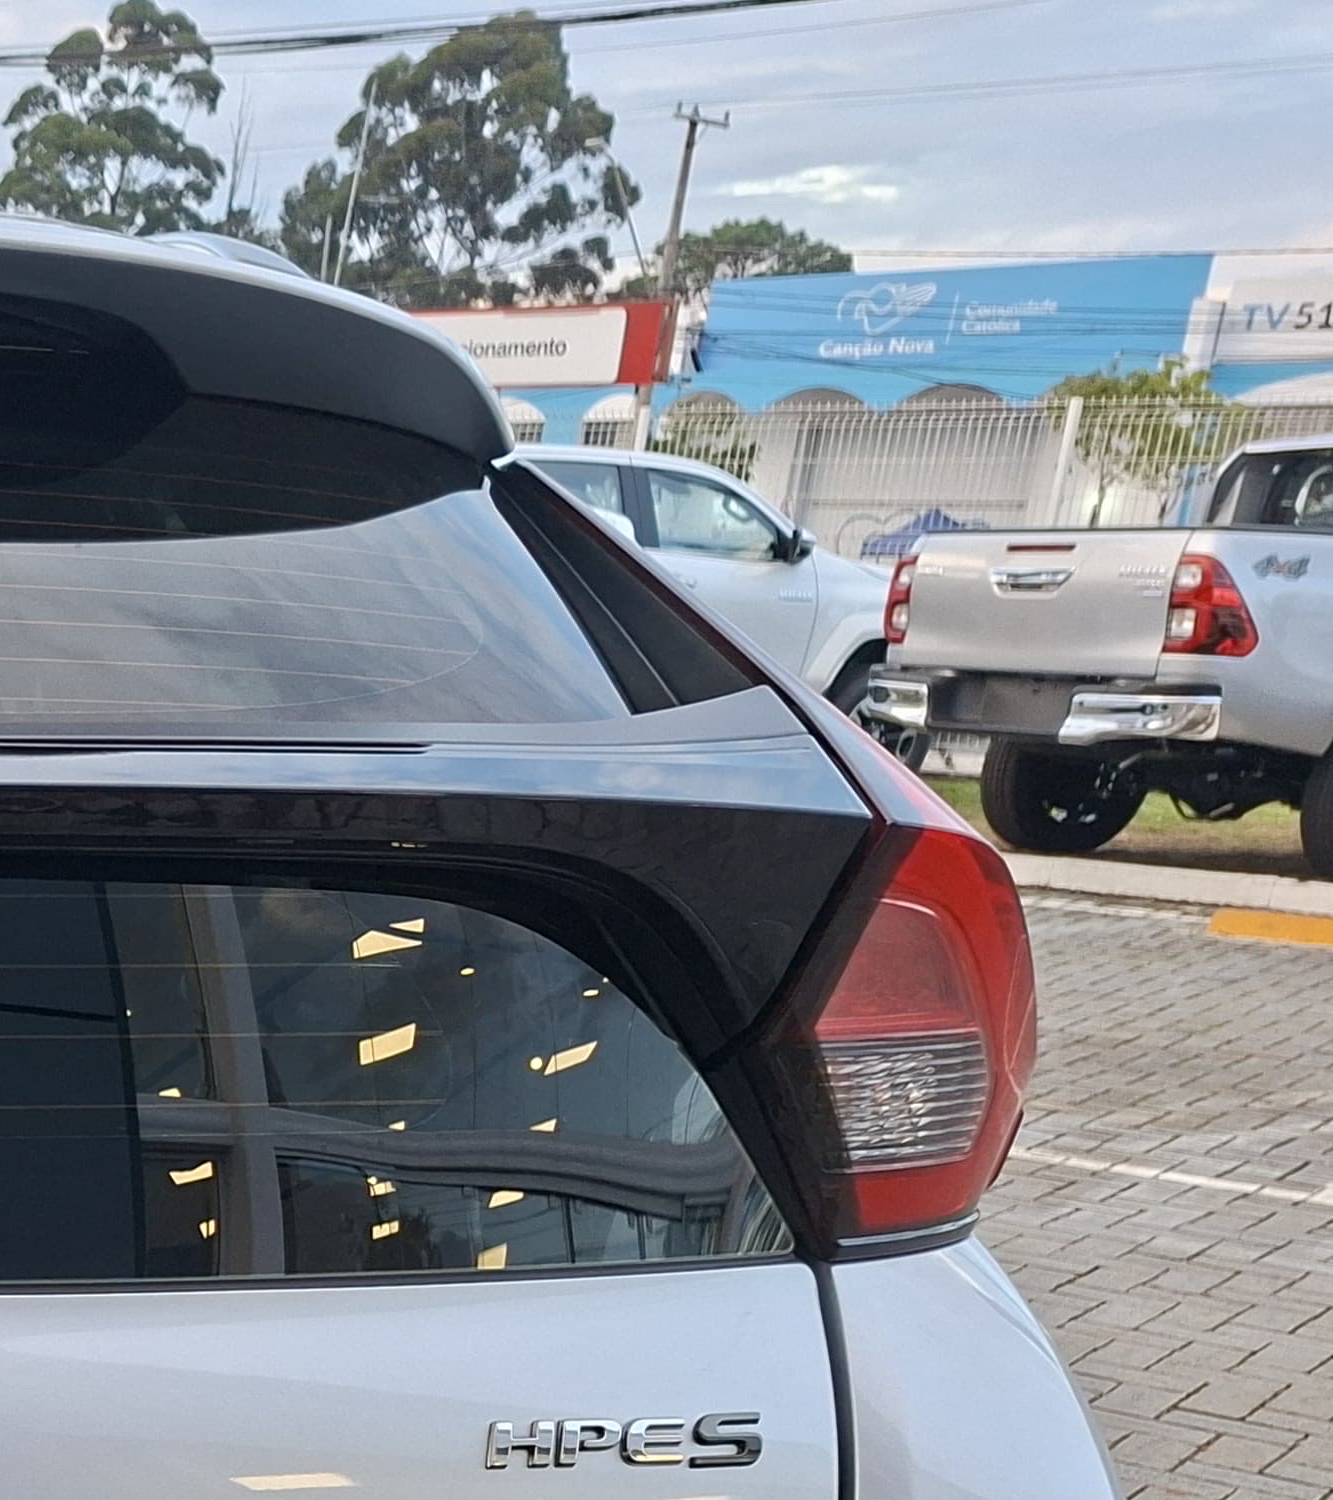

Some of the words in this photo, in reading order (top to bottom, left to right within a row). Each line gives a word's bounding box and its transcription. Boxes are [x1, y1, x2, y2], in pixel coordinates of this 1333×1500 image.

[1242, 302, 1291, 331] TV
[819, 338, 883, 360] Canção
[888, 336, 935, 355] Nova
[485, 1411, 764, 1470] HPES
